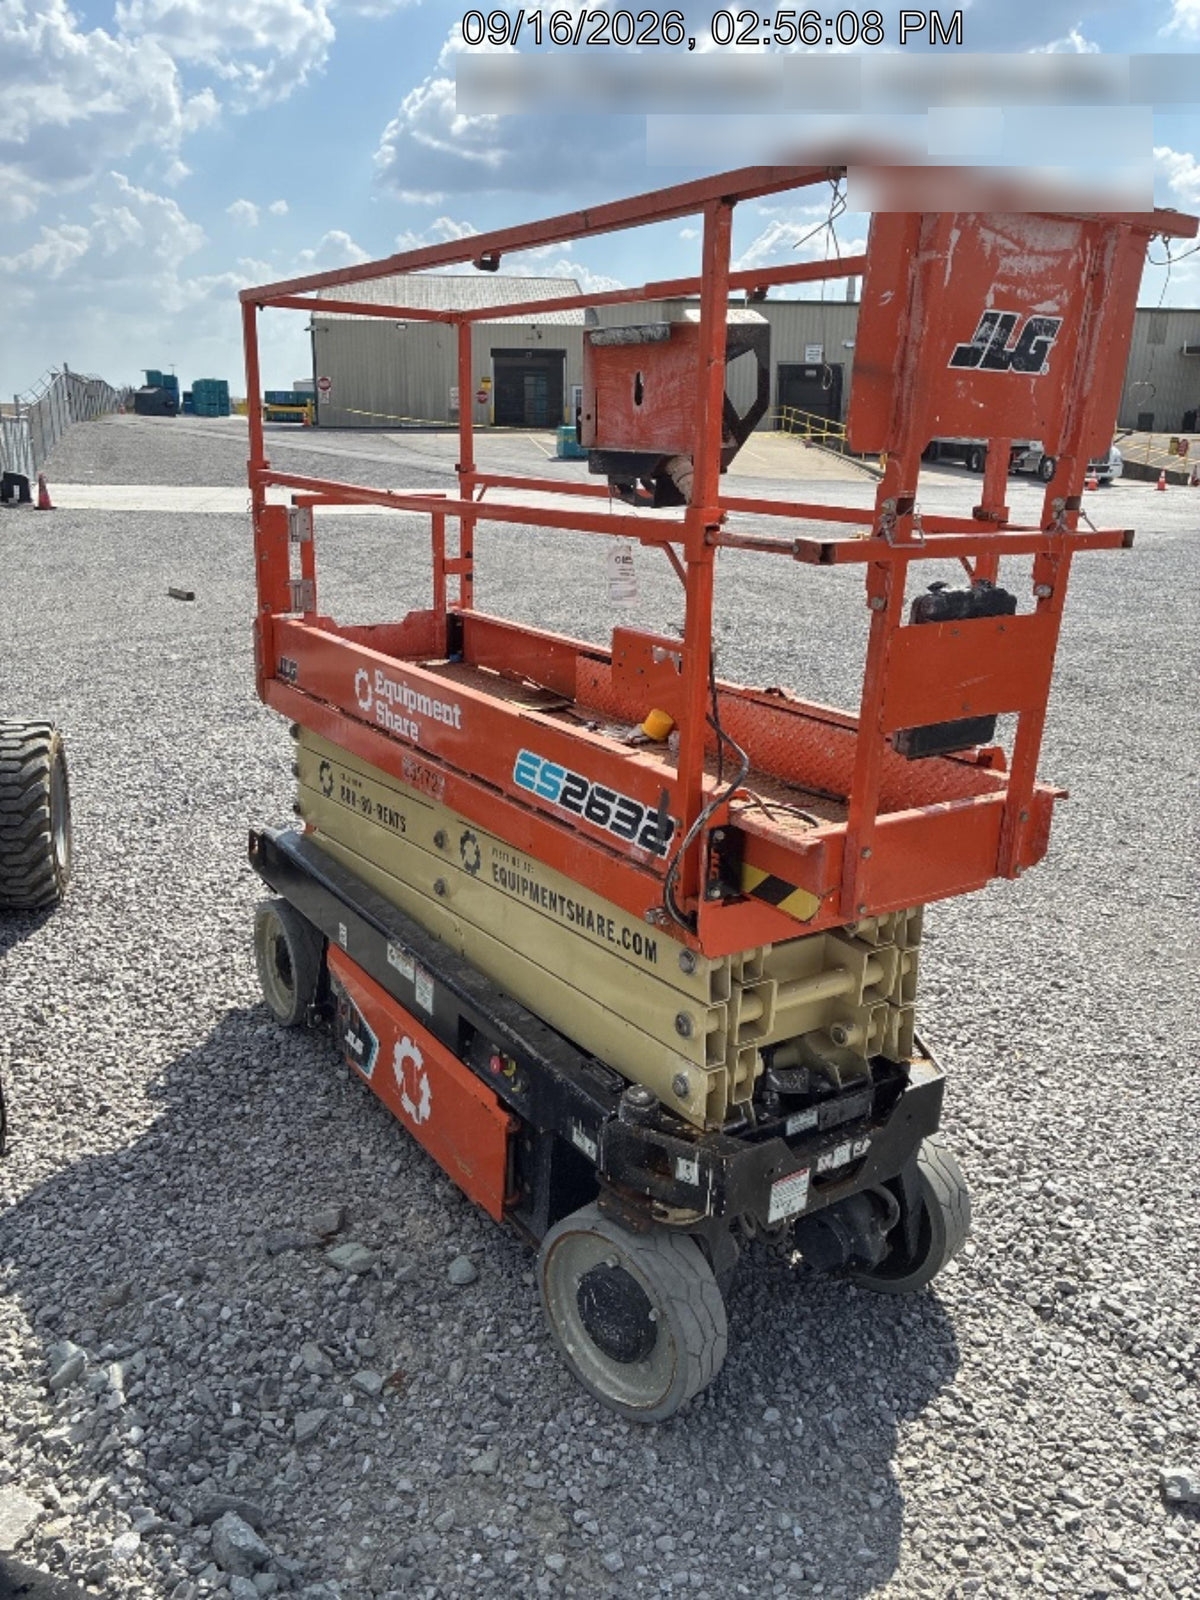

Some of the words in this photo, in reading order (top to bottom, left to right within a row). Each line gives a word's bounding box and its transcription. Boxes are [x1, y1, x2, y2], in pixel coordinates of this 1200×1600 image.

[947, 309, 1064, 376] JLG
[374, 669, 462, 729] Equipment
[375, 700, 419, 742] Share
[513, 749, 677, 860] ES2632
[492, 862, 657, 964] EQUIPMENTSHARE.COM
